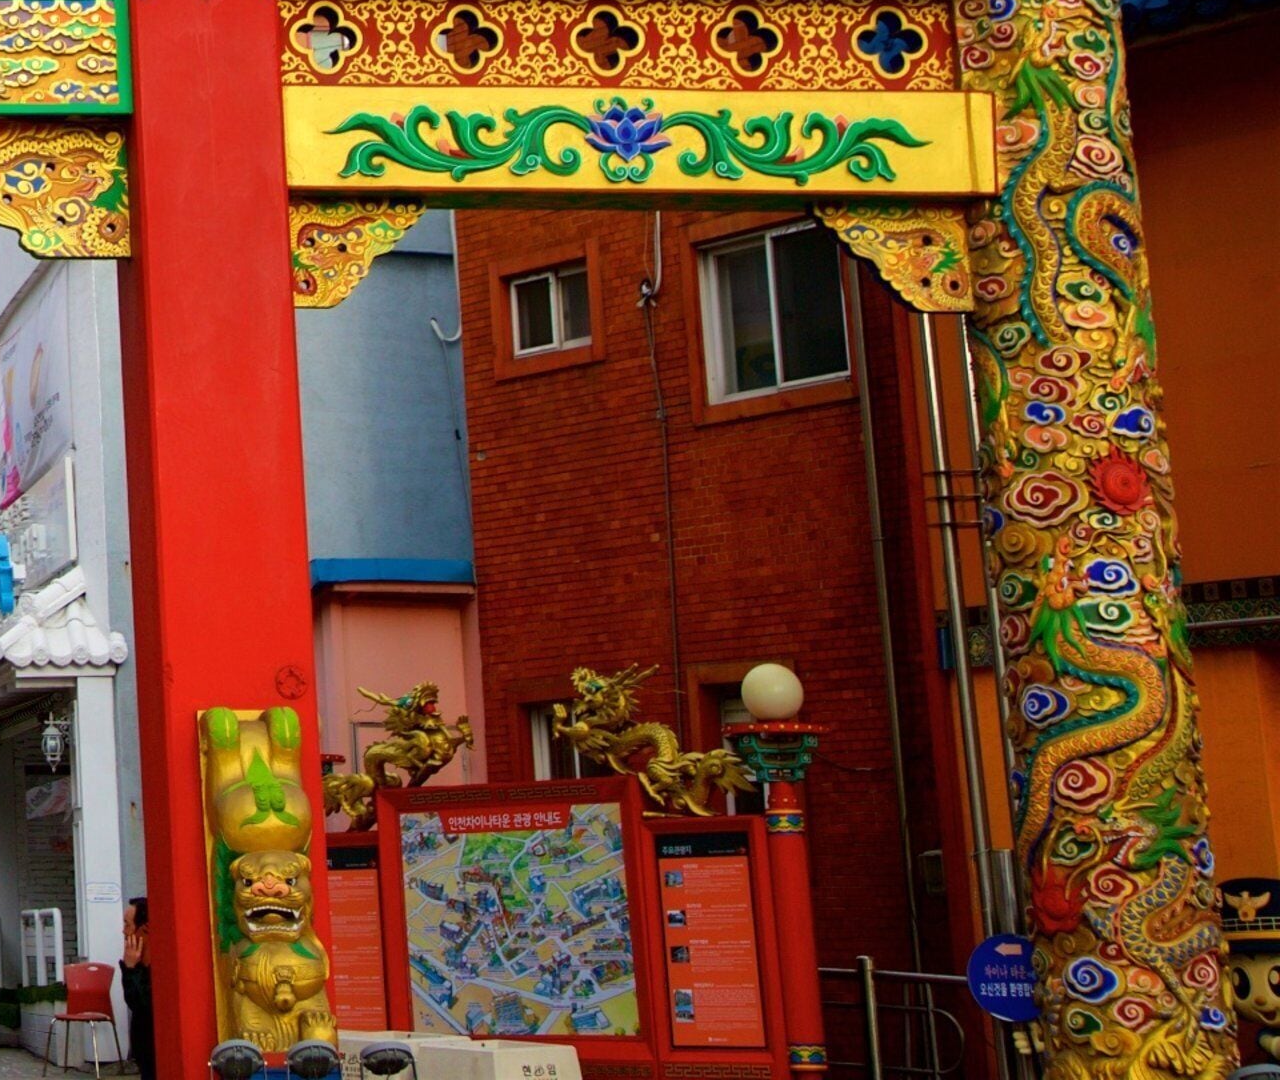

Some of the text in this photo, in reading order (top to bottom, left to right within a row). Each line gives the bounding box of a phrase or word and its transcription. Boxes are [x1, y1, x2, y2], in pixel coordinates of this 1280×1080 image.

[448, 810, 562, 831] 인천차이나타운 관광 안내도
